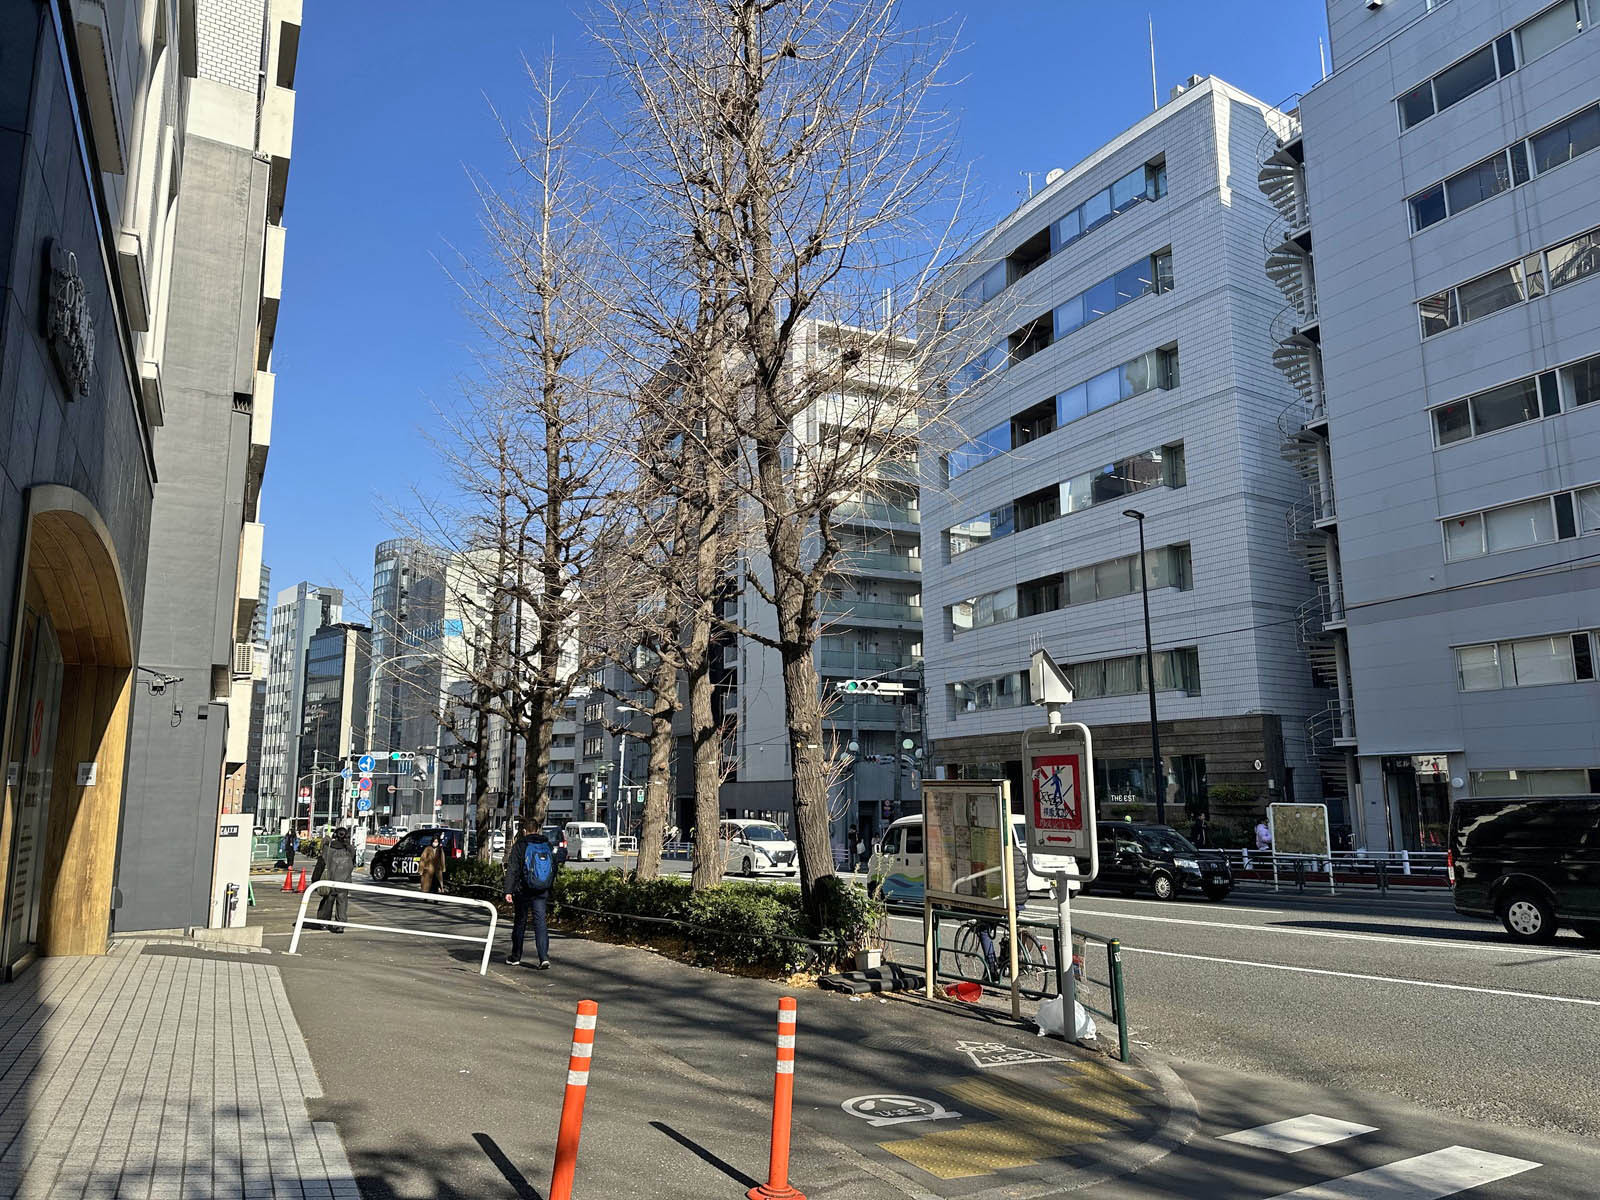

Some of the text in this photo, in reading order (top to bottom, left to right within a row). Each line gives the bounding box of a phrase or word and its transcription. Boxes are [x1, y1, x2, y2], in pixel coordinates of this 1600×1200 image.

[391, 860, 420, 874] S.RID
[874, 1106, 928, 1118] とまれ
